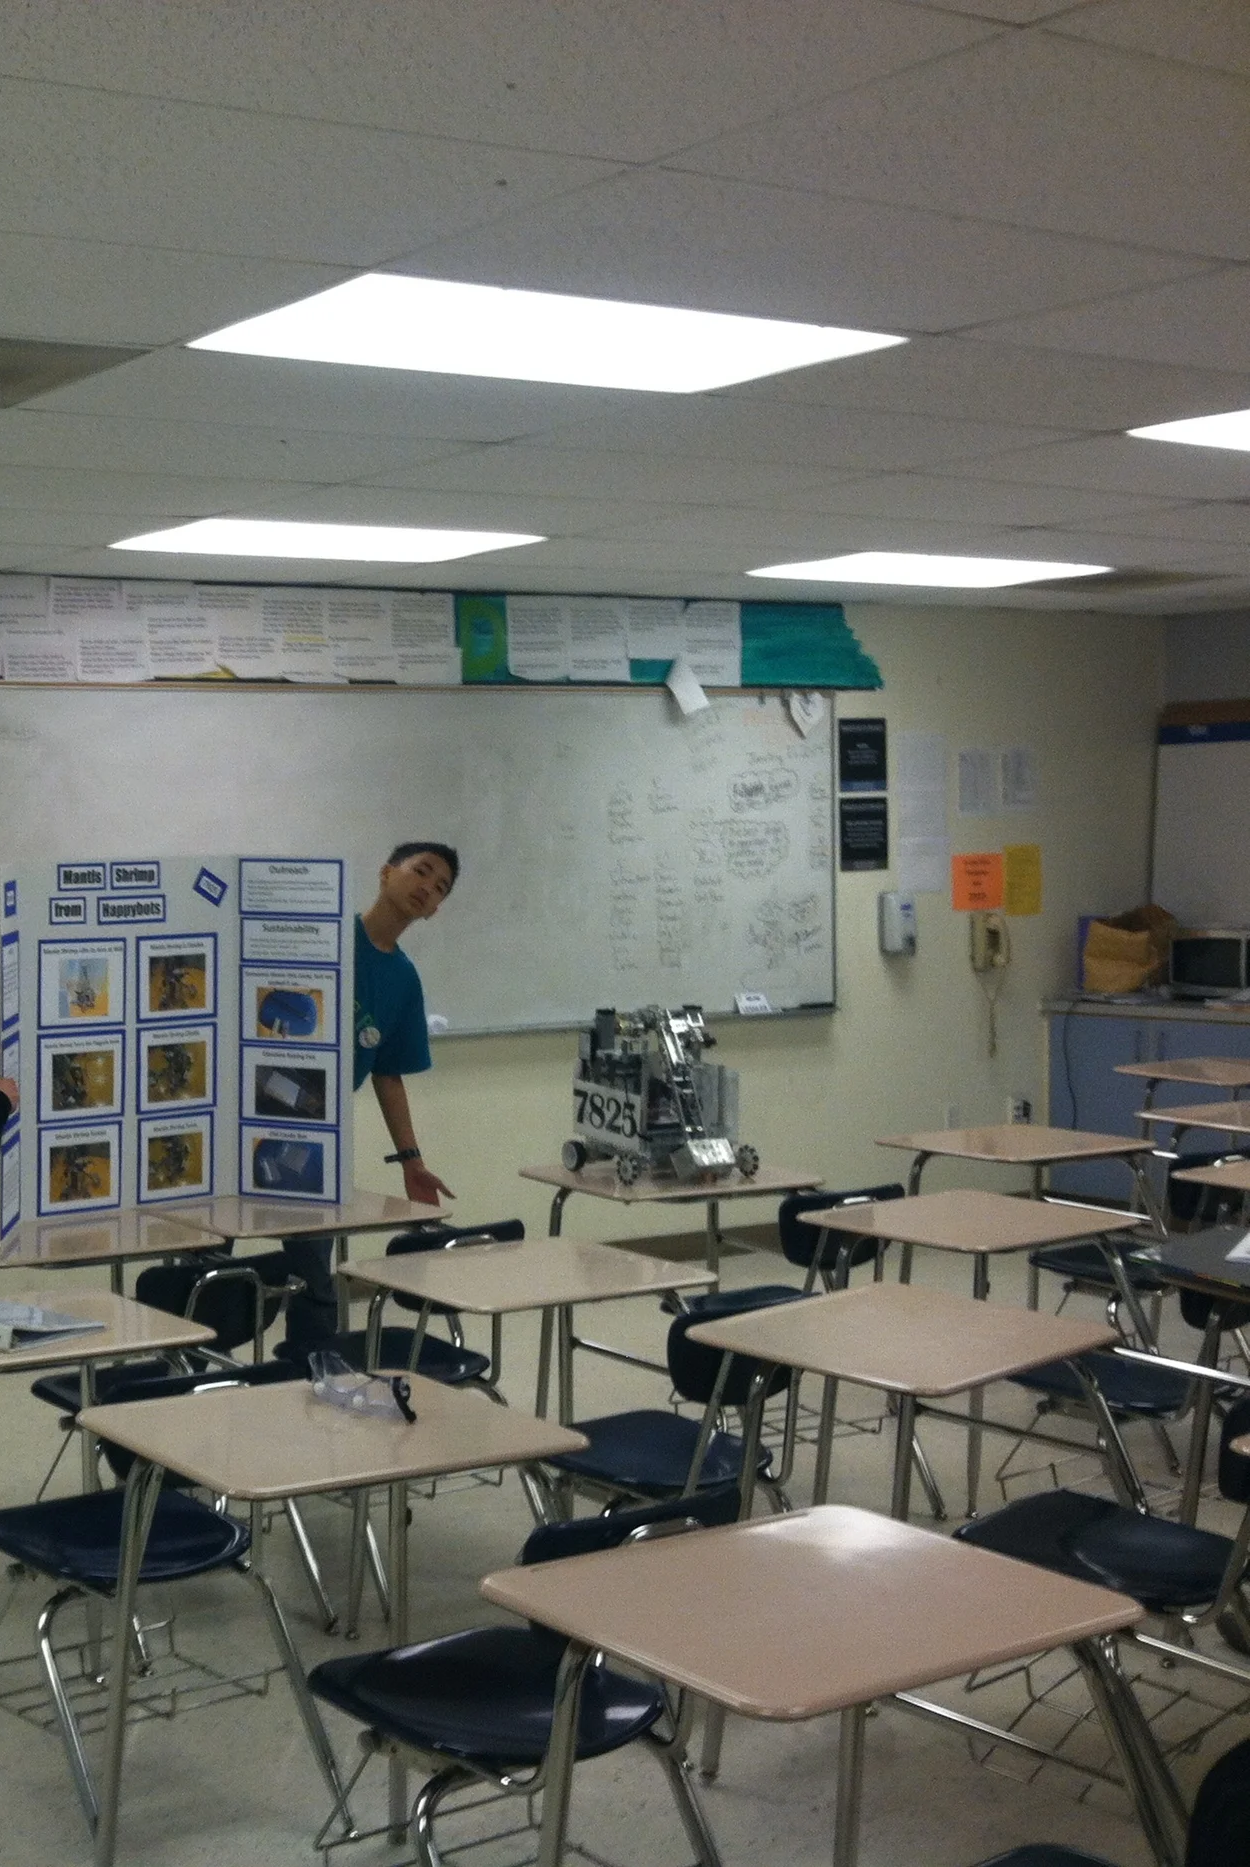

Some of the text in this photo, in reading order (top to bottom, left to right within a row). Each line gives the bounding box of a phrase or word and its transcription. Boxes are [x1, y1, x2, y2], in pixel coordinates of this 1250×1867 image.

[62, 867, 155, 884] Mantis Shrimp
[268, 865, 309, 875] Outreach
[54, 901, 161, 917] from Happybots
[262, 923, 319, 935] Sustainability
[573, 1088, 638, 1138] 7825
